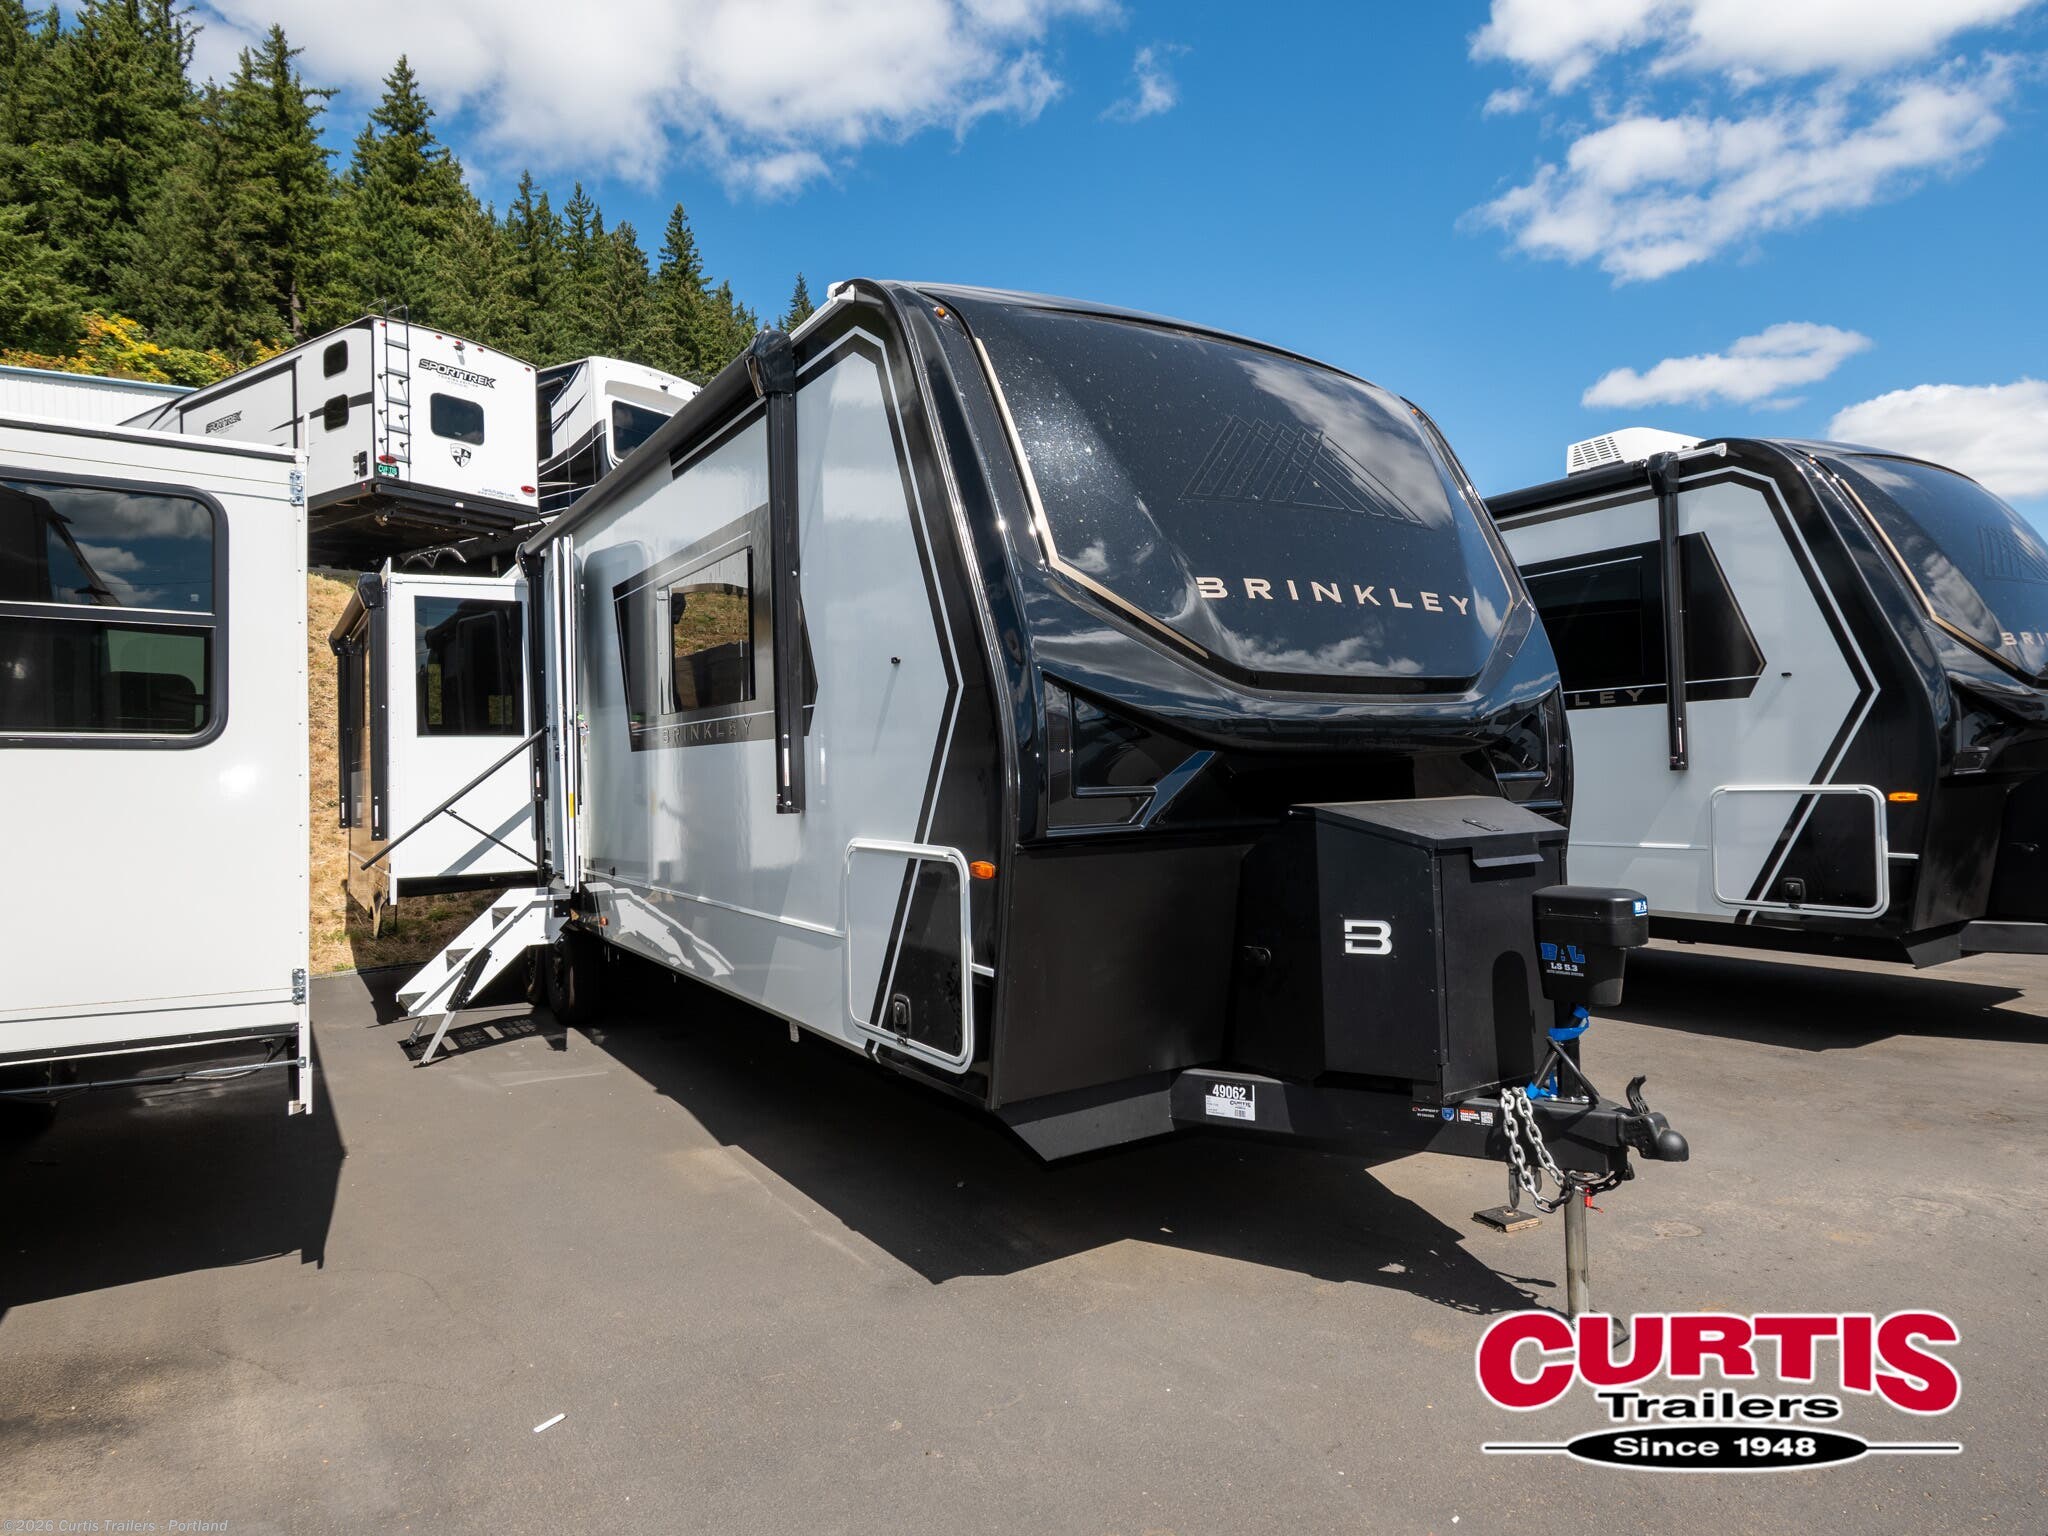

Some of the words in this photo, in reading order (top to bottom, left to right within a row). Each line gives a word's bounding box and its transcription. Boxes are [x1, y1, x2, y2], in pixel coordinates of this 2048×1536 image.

[418, 358, 496, 389] SPORTTREK
[1195, 577, 1469, 615] BRINKLEY
[2001, 632, 2048, 646] BRI
[663, 717, 752, 743] BRINKLEY
[1550, 962, 1563, 970] LS
[1564, 963, 1578, 972] 5.3
[1212, 1084, 1246, 1100] 49062
